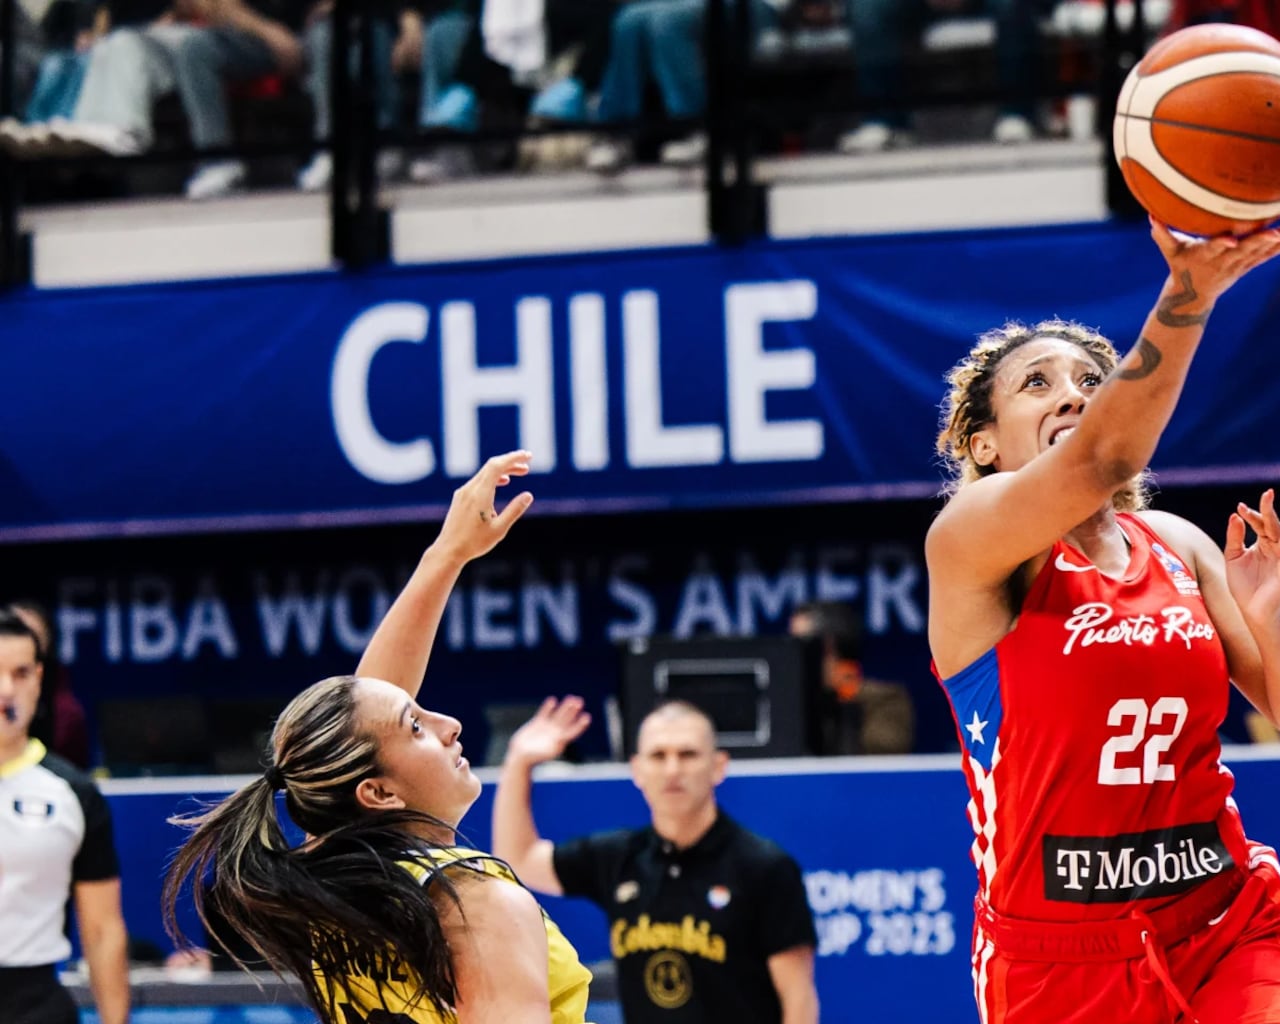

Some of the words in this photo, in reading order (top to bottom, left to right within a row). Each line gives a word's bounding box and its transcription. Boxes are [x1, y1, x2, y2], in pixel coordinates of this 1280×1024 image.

[331, 280, 825, 485] CHILE
[57, 574, 239, 664] FIBA
[1063, 602, 1159, 655] Puerto
[1161, 606, 1215, 650] Rico
[1098, 697, 1188, 785] 22
[1095, 838, 1223, 890] Mobile
[610, 913, 726, 963] Colombia
